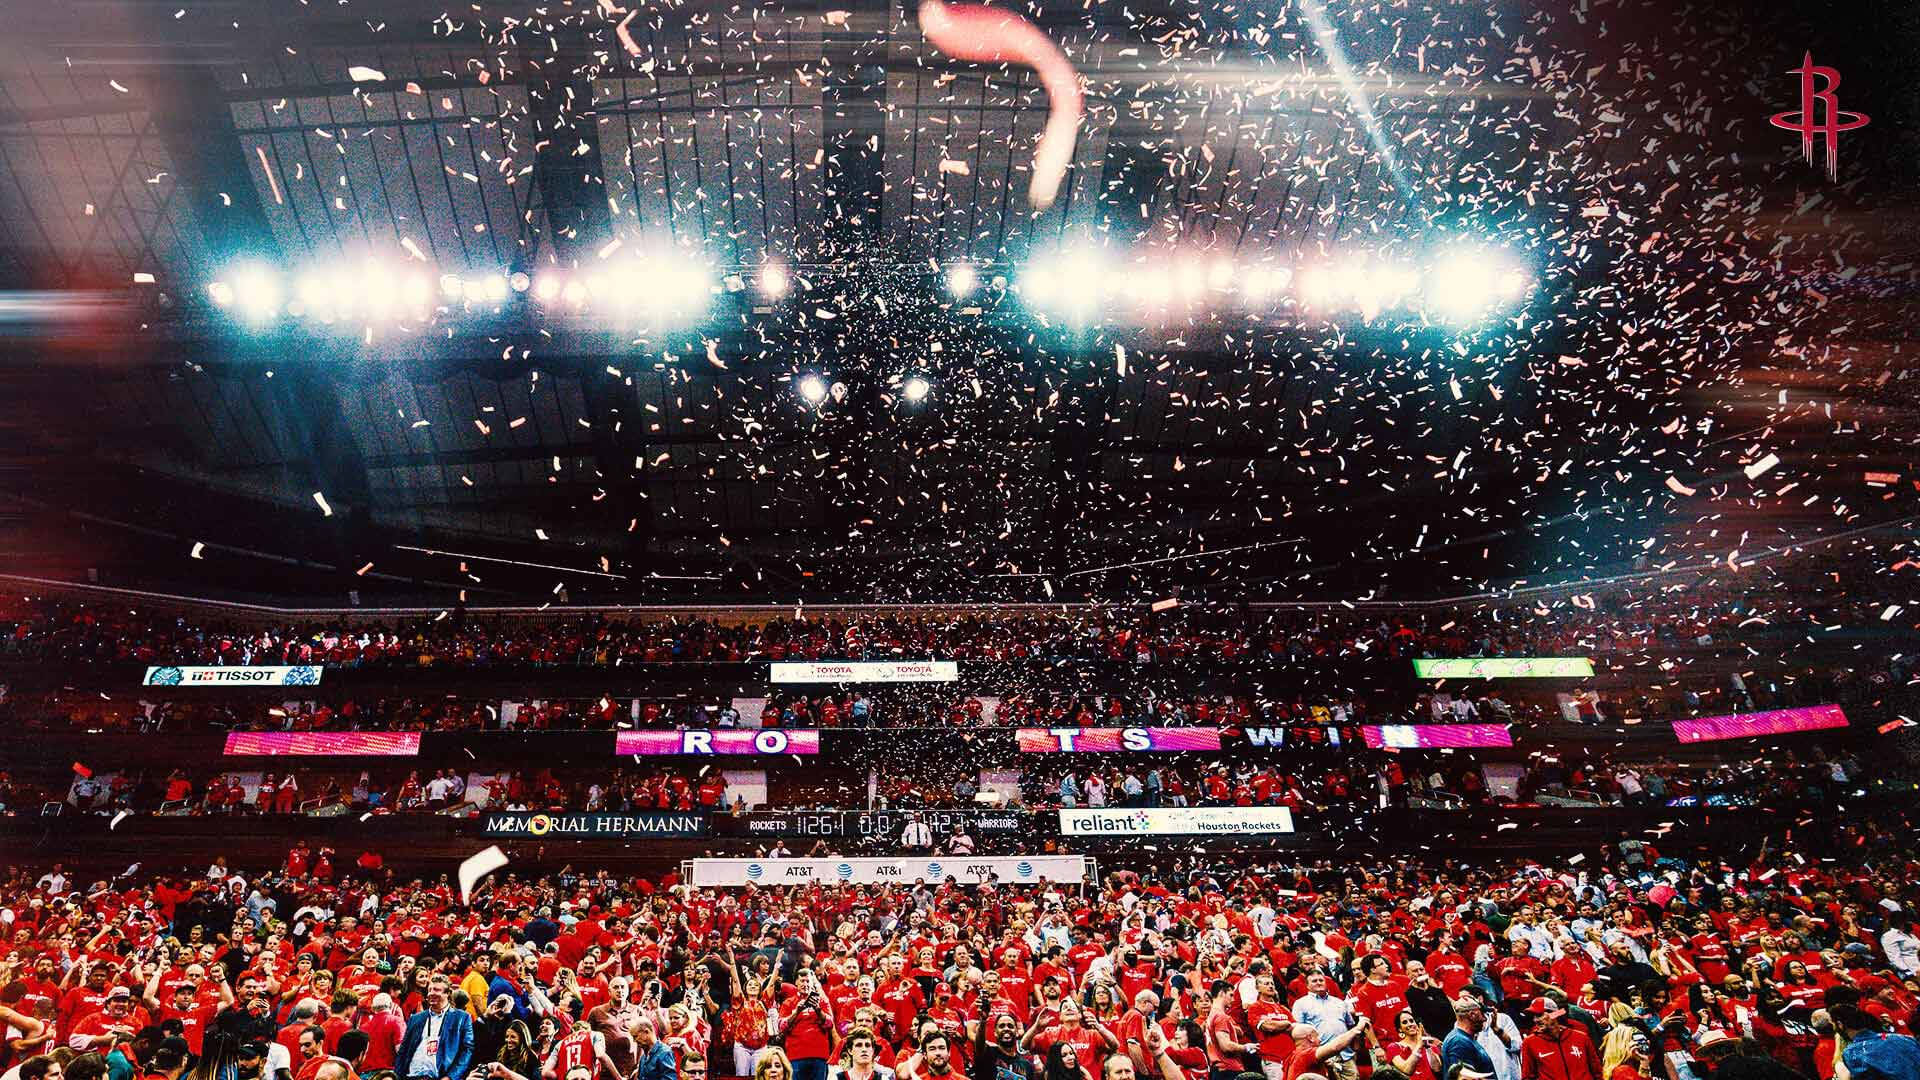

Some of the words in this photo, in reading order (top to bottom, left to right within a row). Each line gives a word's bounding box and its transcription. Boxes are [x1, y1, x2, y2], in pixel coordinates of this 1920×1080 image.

[216, 671, 275, 681] TISSOT
[486, 814, 590, 835] MEMORIAL
[596, 817, 702, 832] HERMANN
[750, 820, 787, 831] ROCKETS
[977, 818, 1019, 829] WARRIORS
[1072, 814, 1137, 831] reliant
[1198, 822, 1240, 830] Houston
[1242, 822, 1281, 830] Rockets
[786, 866, 814, 876] AT&T
[966, 865, 994, 875] AT&T
